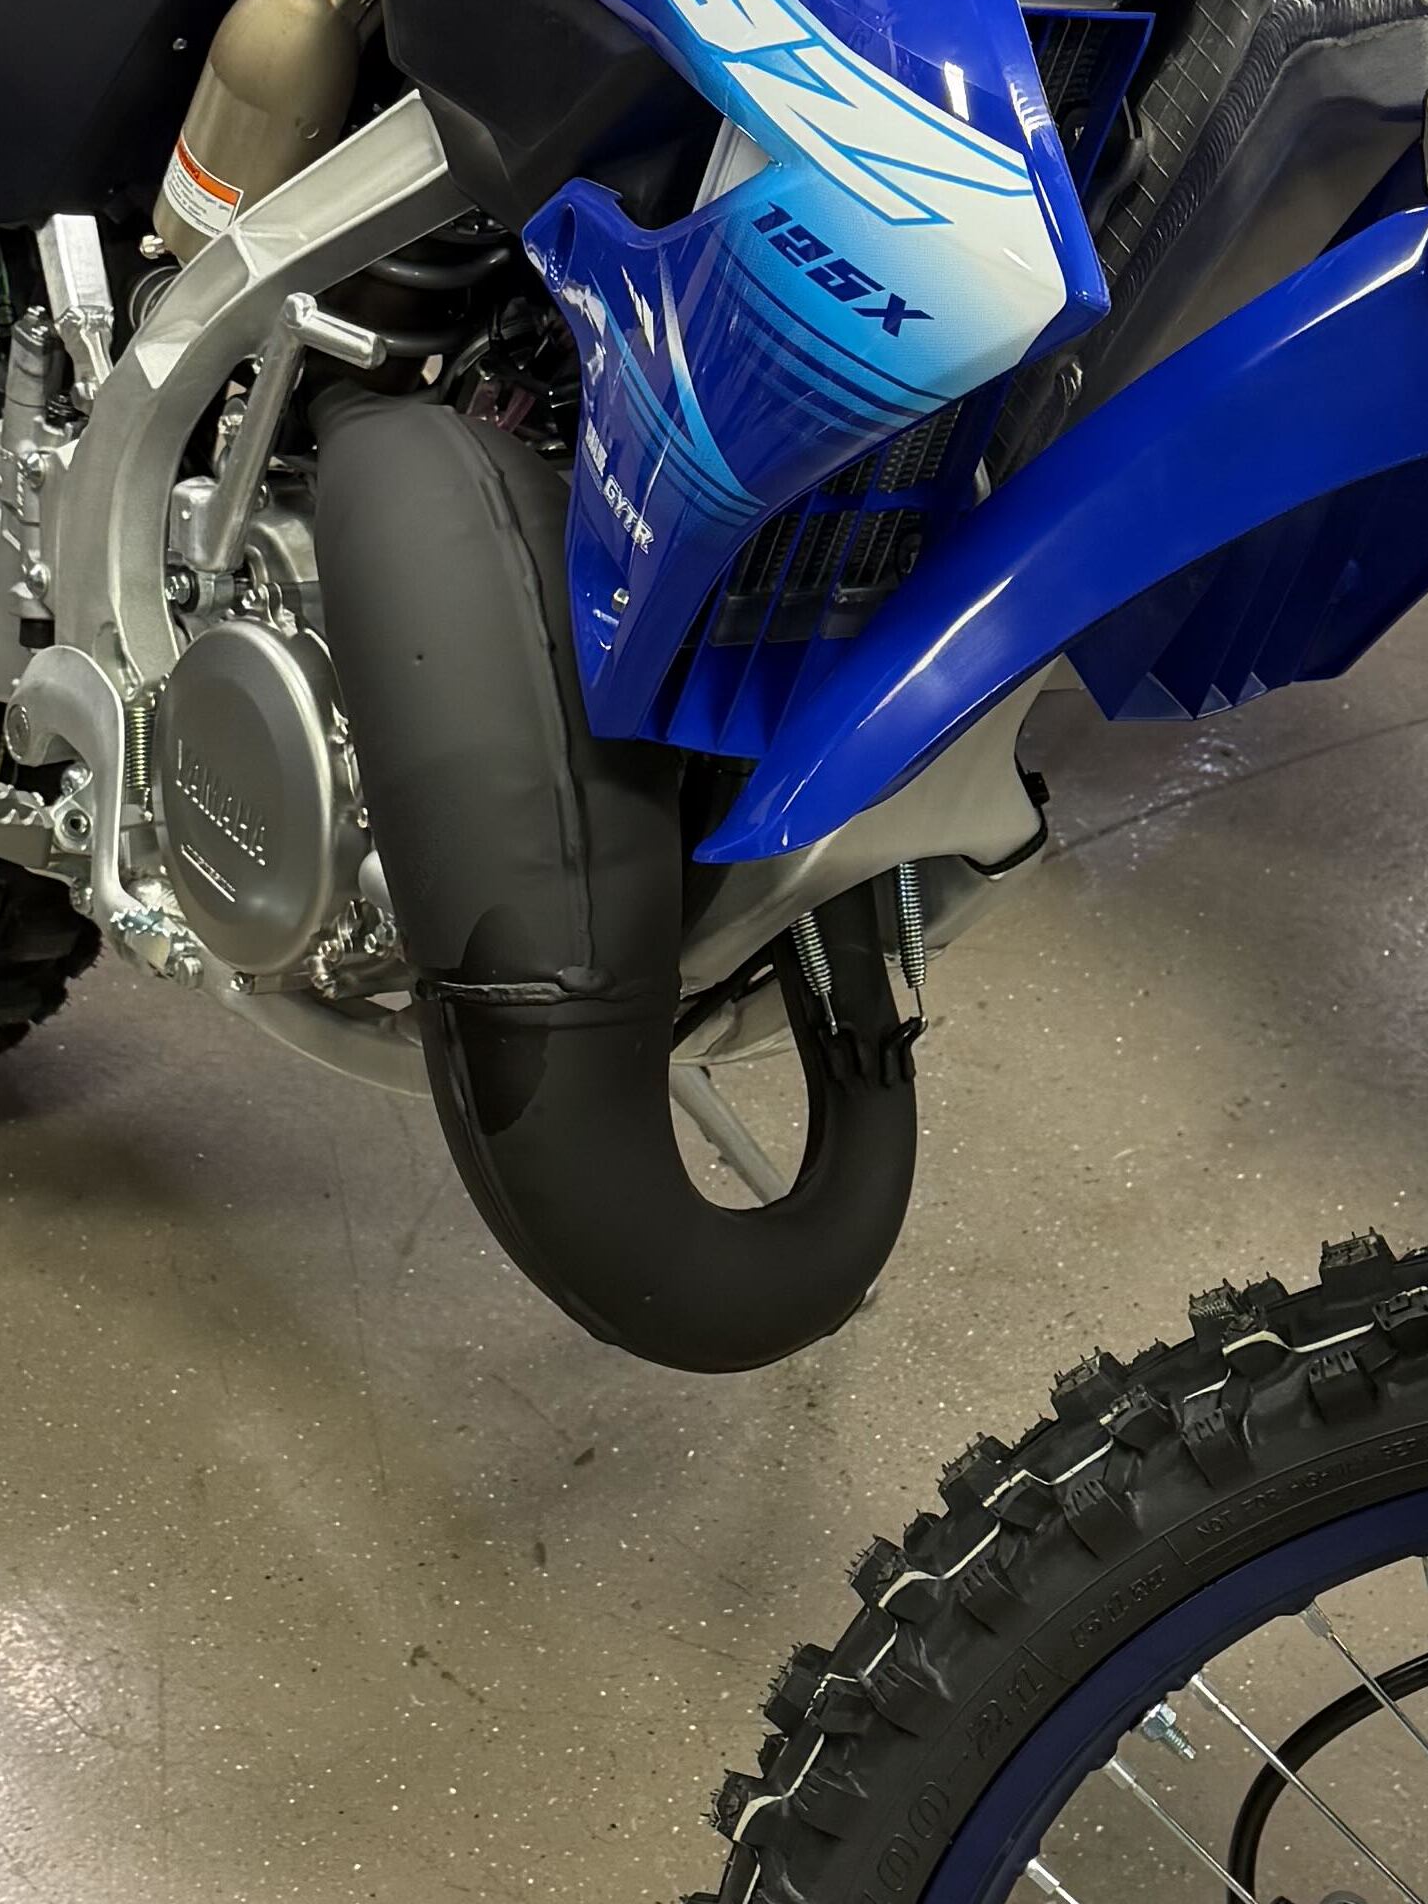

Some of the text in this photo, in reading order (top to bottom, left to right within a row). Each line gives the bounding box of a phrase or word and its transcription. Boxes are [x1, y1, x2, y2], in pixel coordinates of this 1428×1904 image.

[751, 200, 935, 338] 125X
[603, 474, 655, 555] GYTR
[175, 739, 267, 867] YAMAHA
